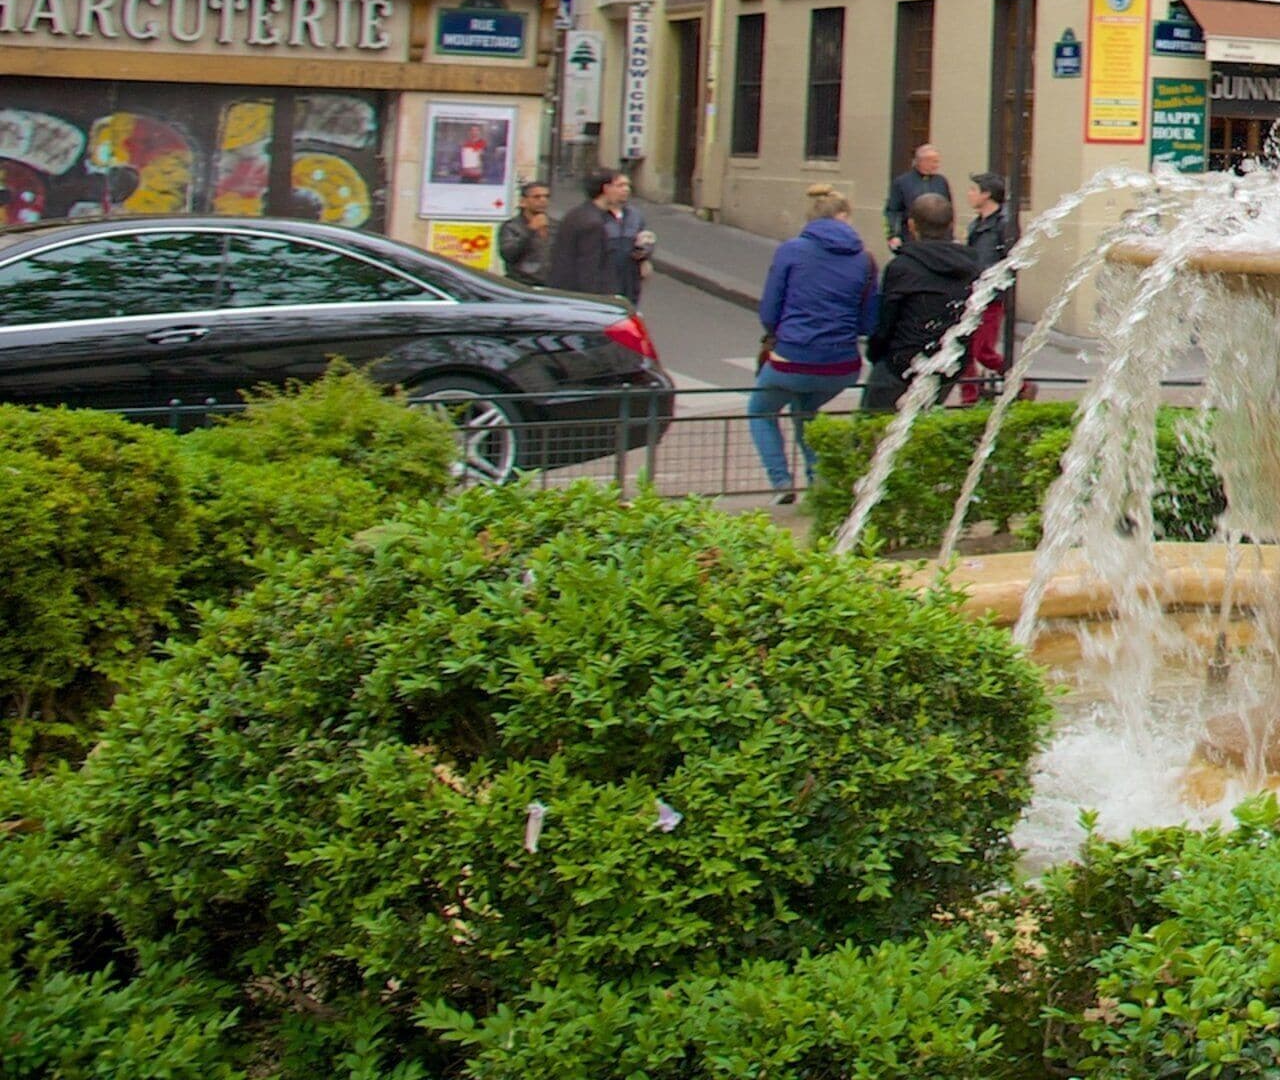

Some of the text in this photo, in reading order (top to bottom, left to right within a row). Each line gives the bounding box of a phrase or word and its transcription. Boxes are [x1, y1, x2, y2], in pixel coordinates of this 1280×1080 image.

[470, 18, 496, 32] RUE
[627, 24, 651, 158] SANDWICHERIE
[1154, 111, 1202, 125] HAPPY
[1153, 127, 1196, 140] HOUR
